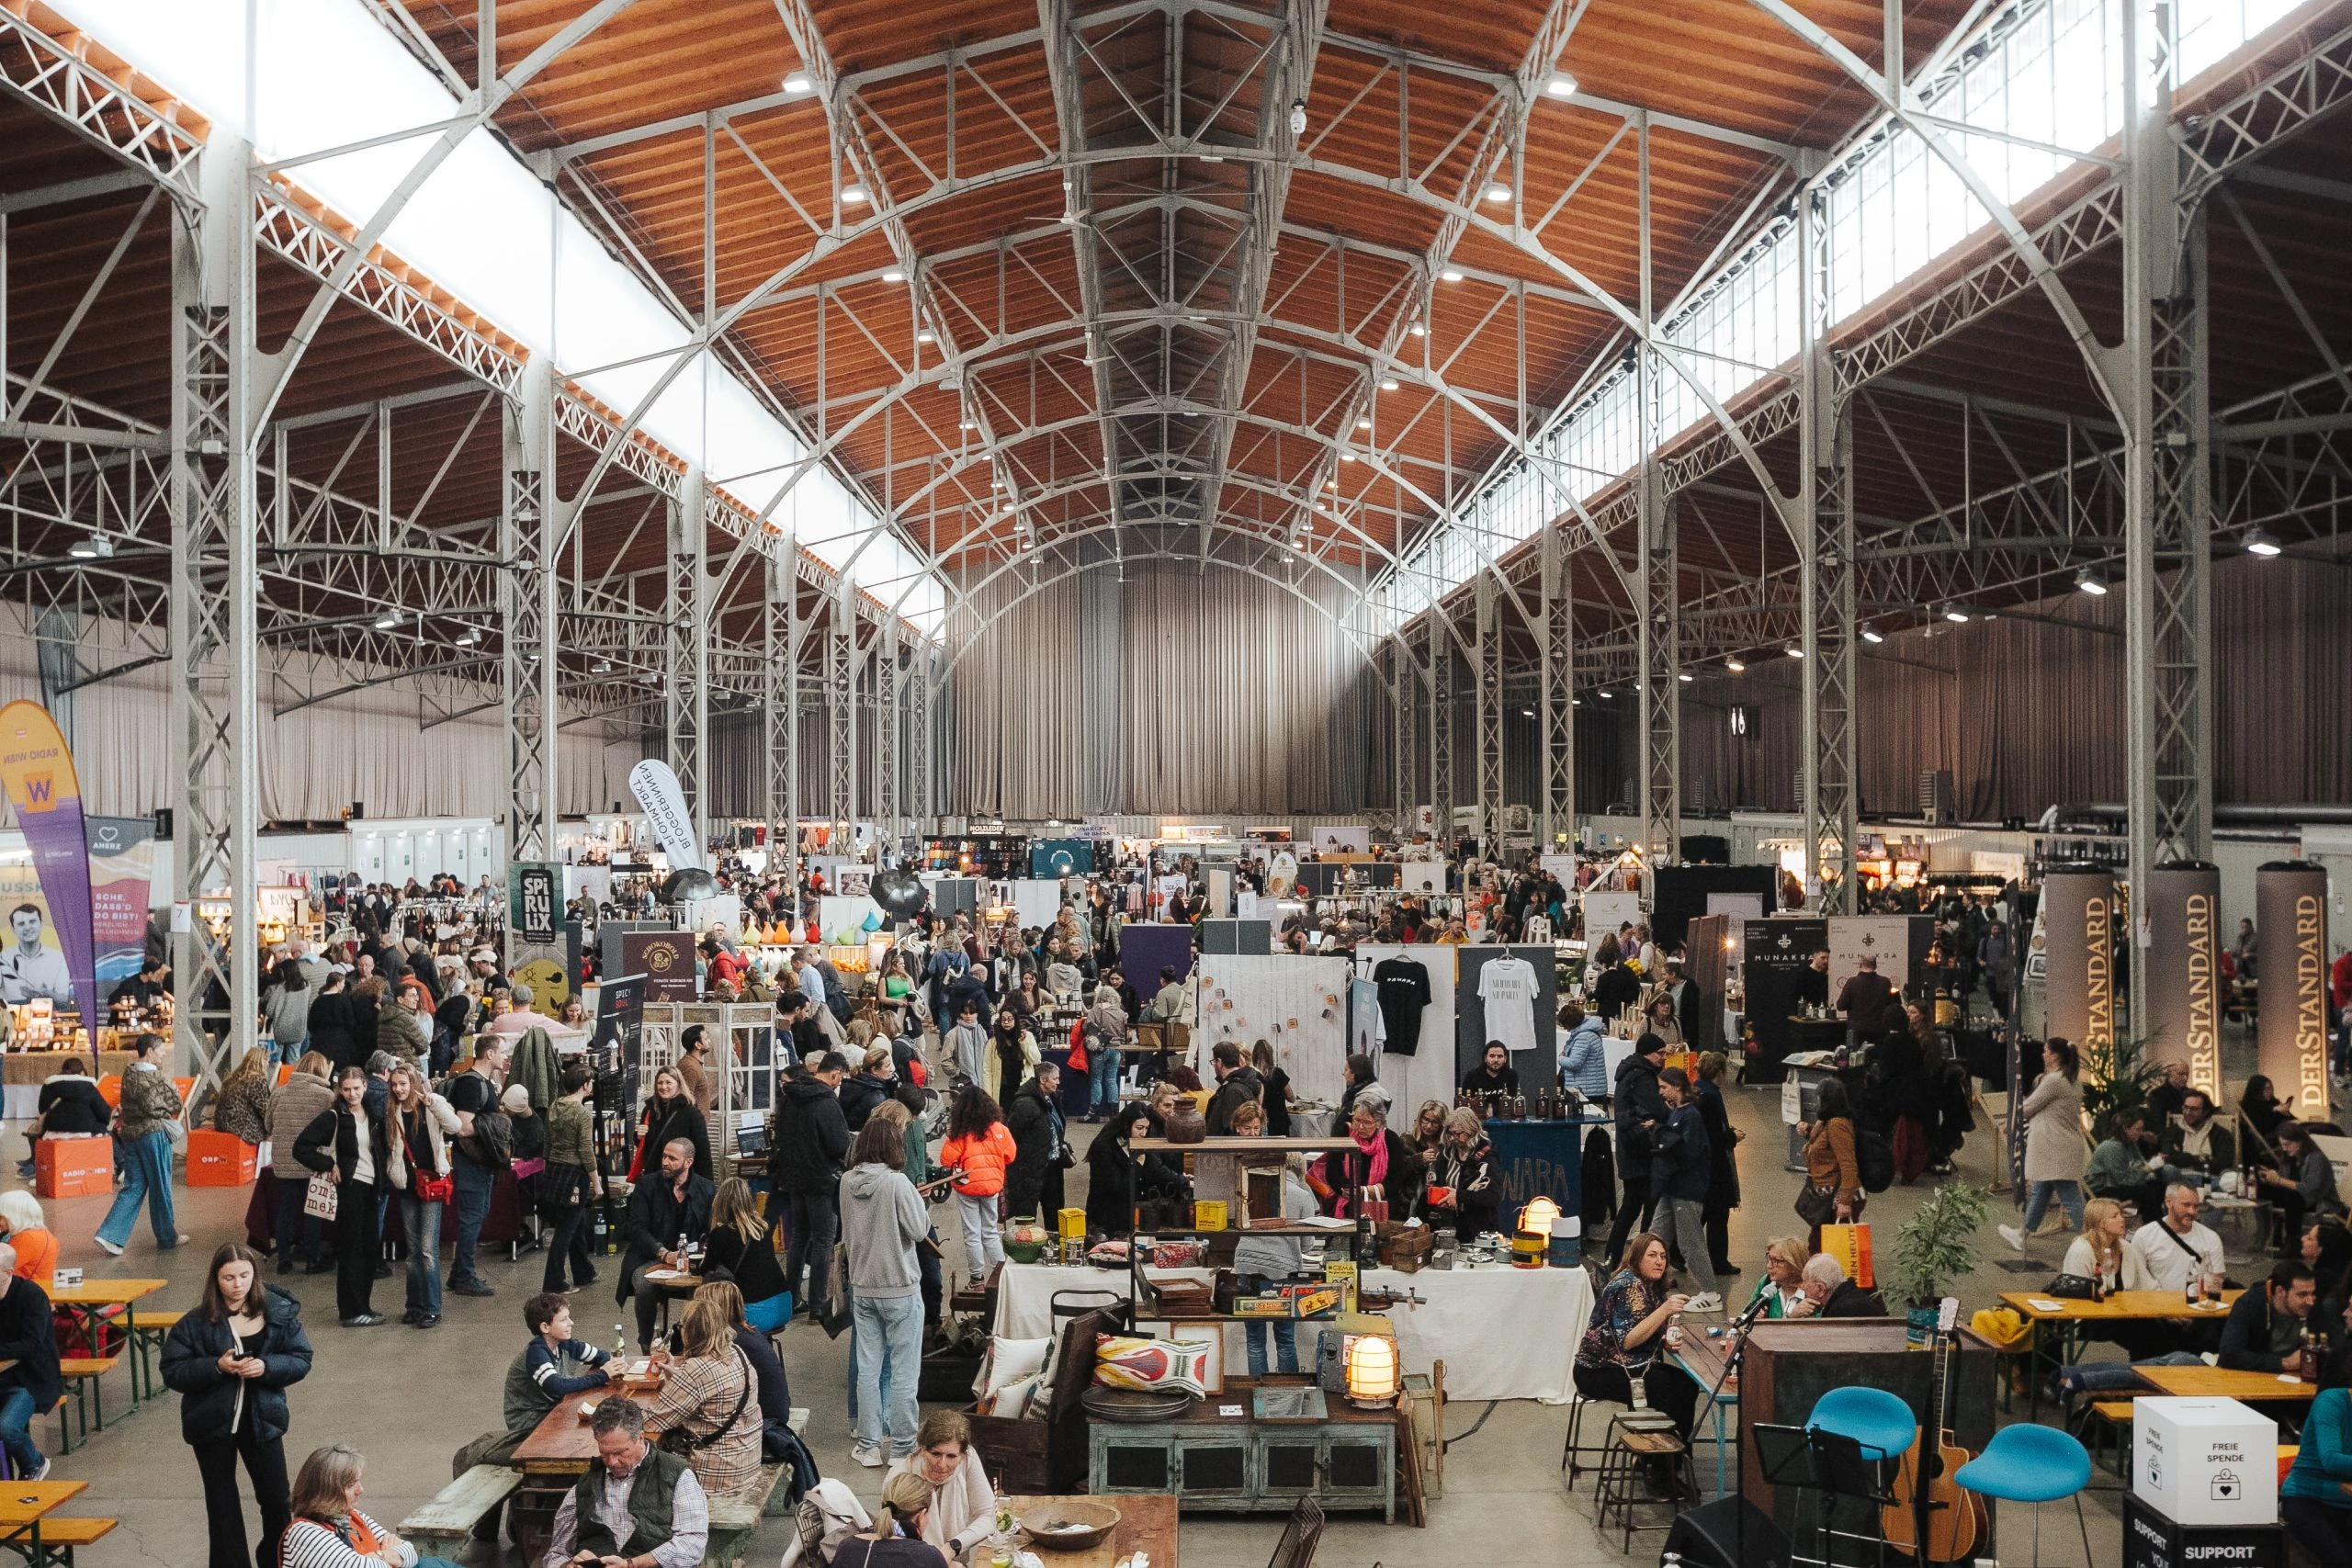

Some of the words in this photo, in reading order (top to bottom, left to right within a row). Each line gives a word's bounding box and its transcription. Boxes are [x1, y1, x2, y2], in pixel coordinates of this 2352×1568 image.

[27, 779, 51, 803] W
[525, 896, 550, 913] RU
[175, 908, 184, 919] 7
[641, 941, 680, 960] SCHOKOBOLD
[615, 988, 632, 999] SPICY
[2296, 895, 2322, 1107] DERSTANDARD
[62, 1168, 85, 1179] RADIO
[1849, 1227, 1857, 1258] HEUTE
[2148, 1427, 2161, 1441] FREIE
[2145, 1437, 2164, 1454] SPENDE
[2212, 1442, 2239, 1450] FREIE
[2207, 1454, 2245, 1462] SPENDE
[2134, 1517, 2167, 1551] SUPPORT
[2184, 1546, 2256, 1560] SUPPORT
